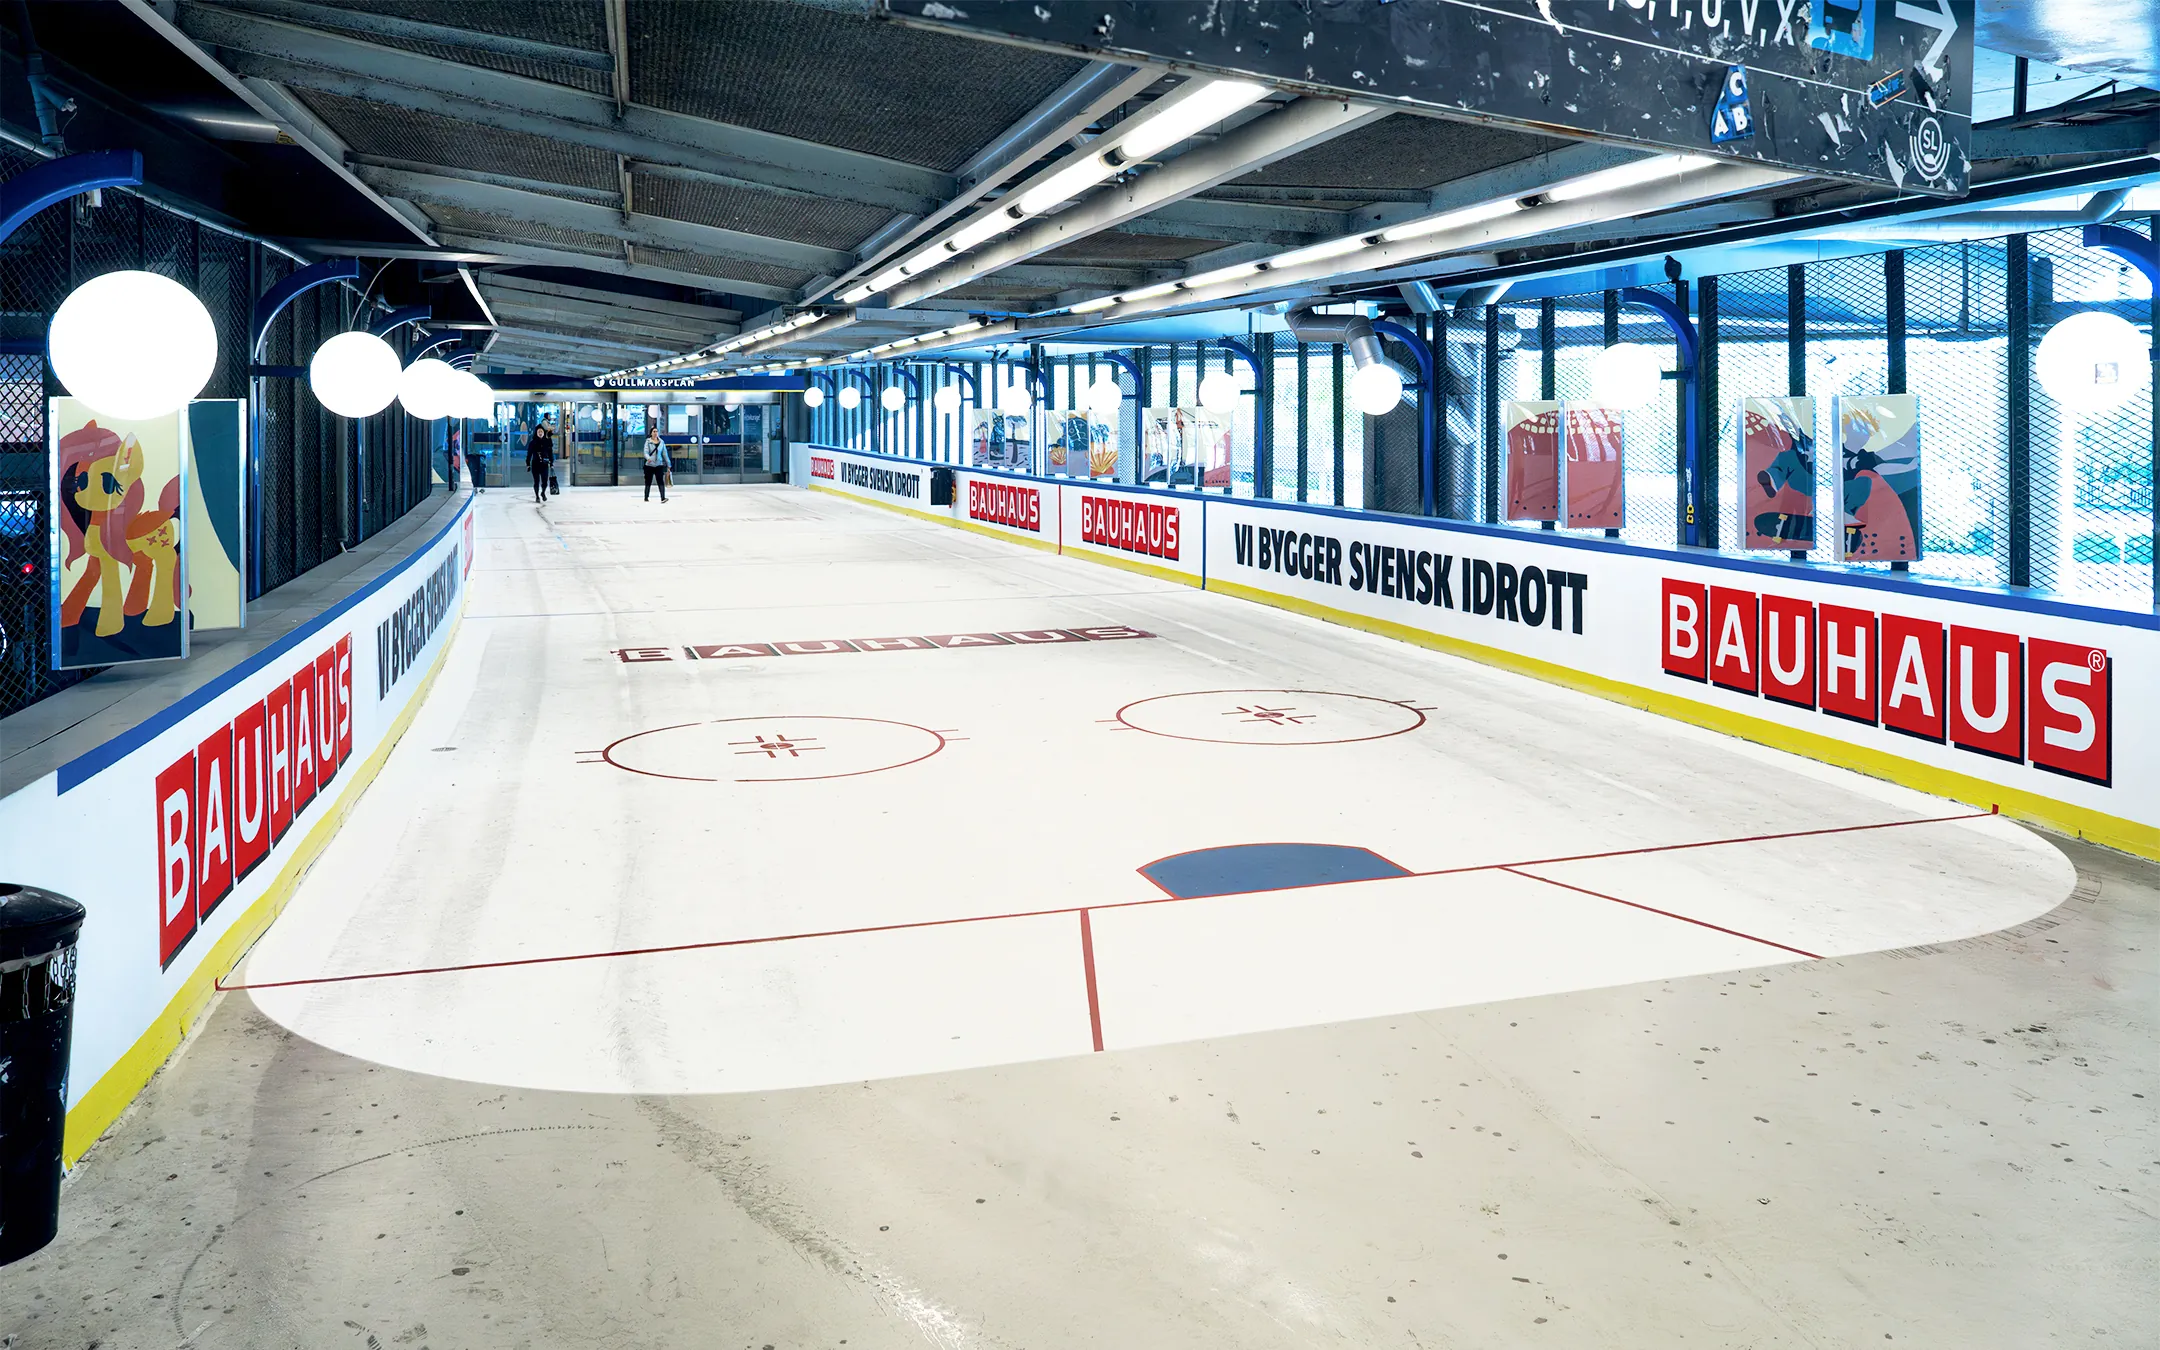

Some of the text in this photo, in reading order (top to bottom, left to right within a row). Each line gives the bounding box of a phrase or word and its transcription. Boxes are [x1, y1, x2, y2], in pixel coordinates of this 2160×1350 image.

[1922, 129, 1938, 151] SL
[608, 378, 695, 387] GULLMARSPLAN
[841, 462, 920, 499] VI BYGGER SVENSK IDROTT
[970, 484, 1039, 524] BAUHAUS
[1083, 501, 1178, 550] BAUHAUS
[1234, 523, 1588, 635] VI BYGGER SVENSK IDROTT
[377, 617, 390, 702] VI
[391, 585, 426, 686] BYGGER
[162, 650, 352, 927] BAUHAUS
